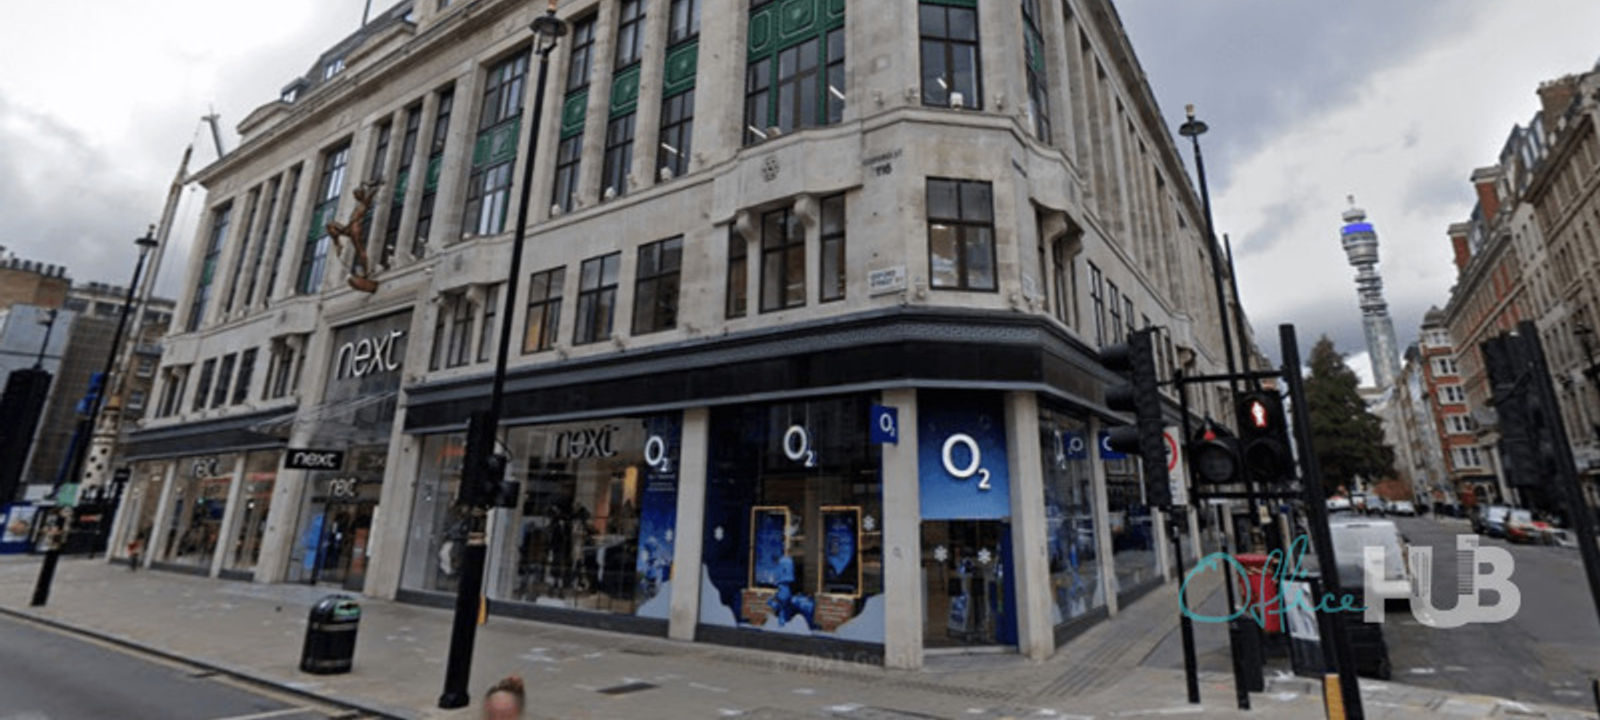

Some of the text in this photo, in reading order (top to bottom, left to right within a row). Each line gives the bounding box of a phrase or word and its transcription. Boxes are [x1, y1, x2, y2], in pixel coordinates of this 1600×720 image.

[335, 330, 402, 380] next
[554, 425, 620, 459] next
[293, 452, 336, 467] next
